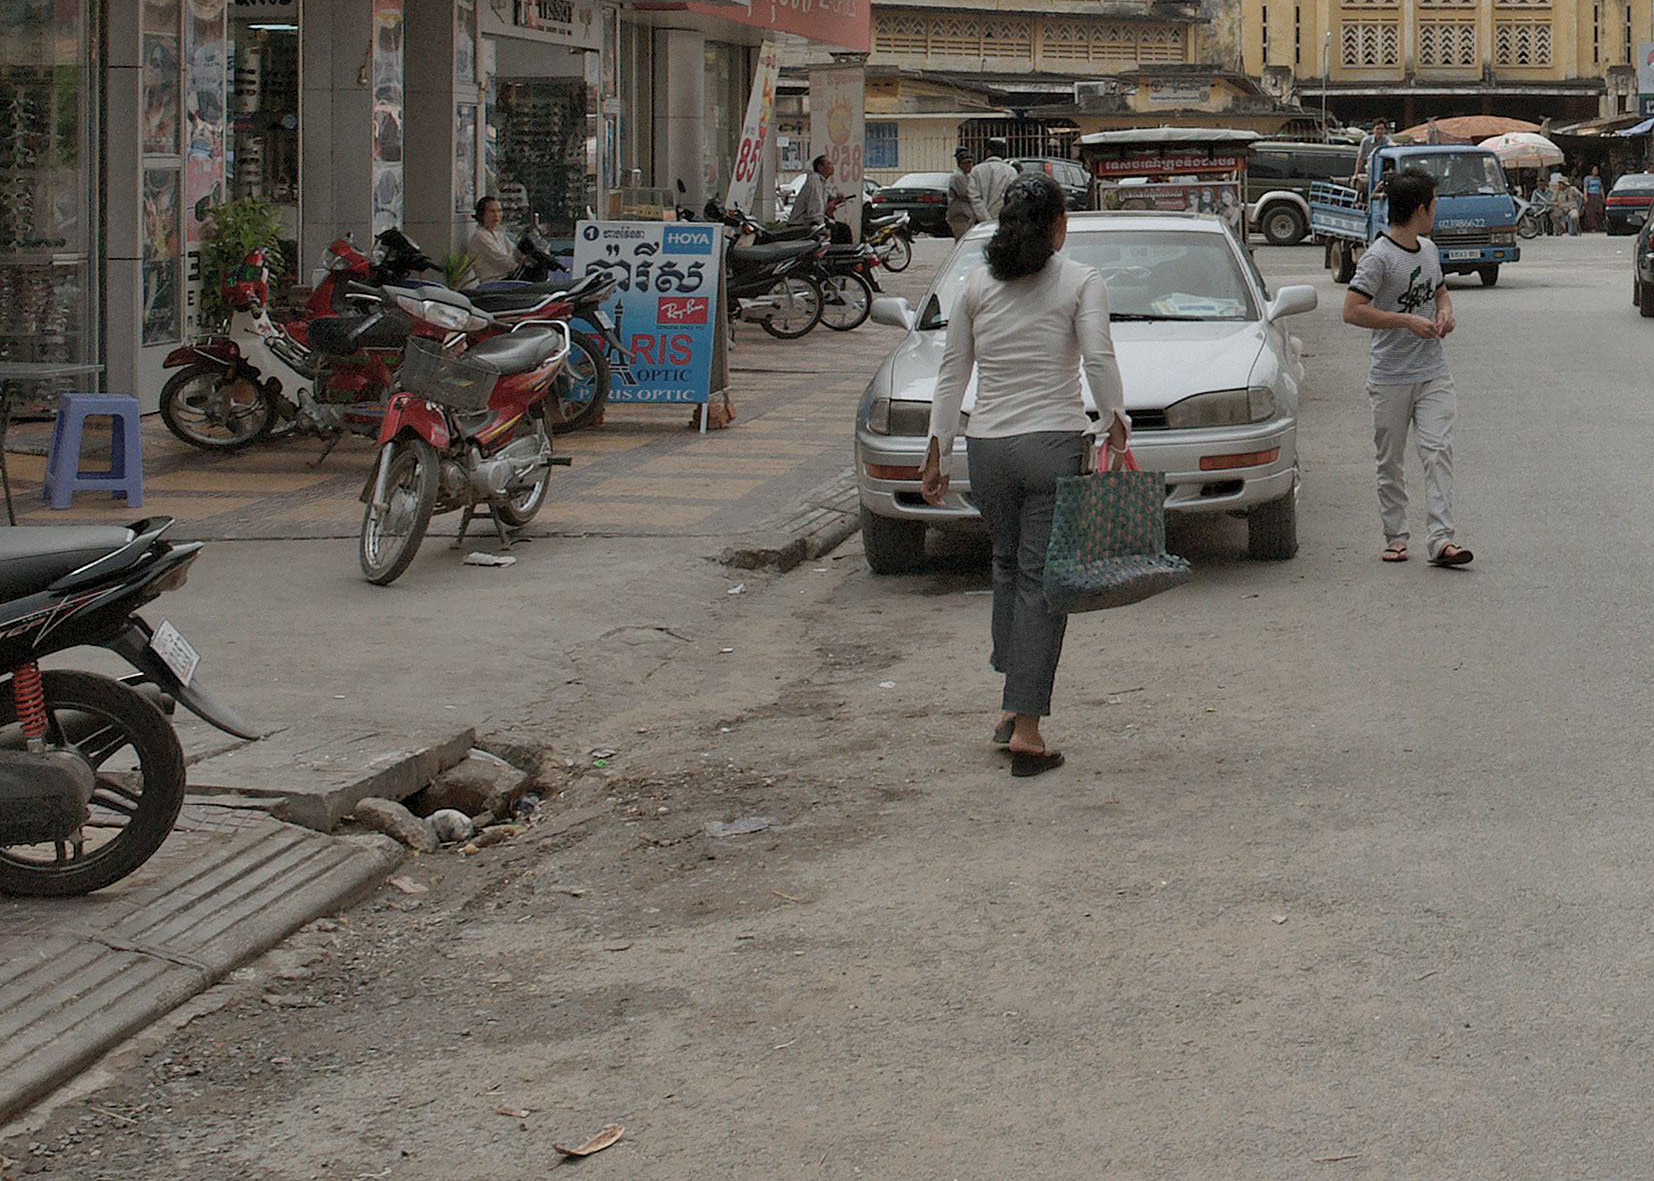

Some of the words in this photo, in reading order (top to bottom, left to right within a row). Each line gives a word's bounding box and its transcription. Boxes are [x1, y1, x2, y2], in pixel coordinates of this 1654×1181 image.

[667, 232, 710, 245] HOYA
[637, 369, 692, 382] OPTIC
[637, 388, 696, 401] OPTIC
